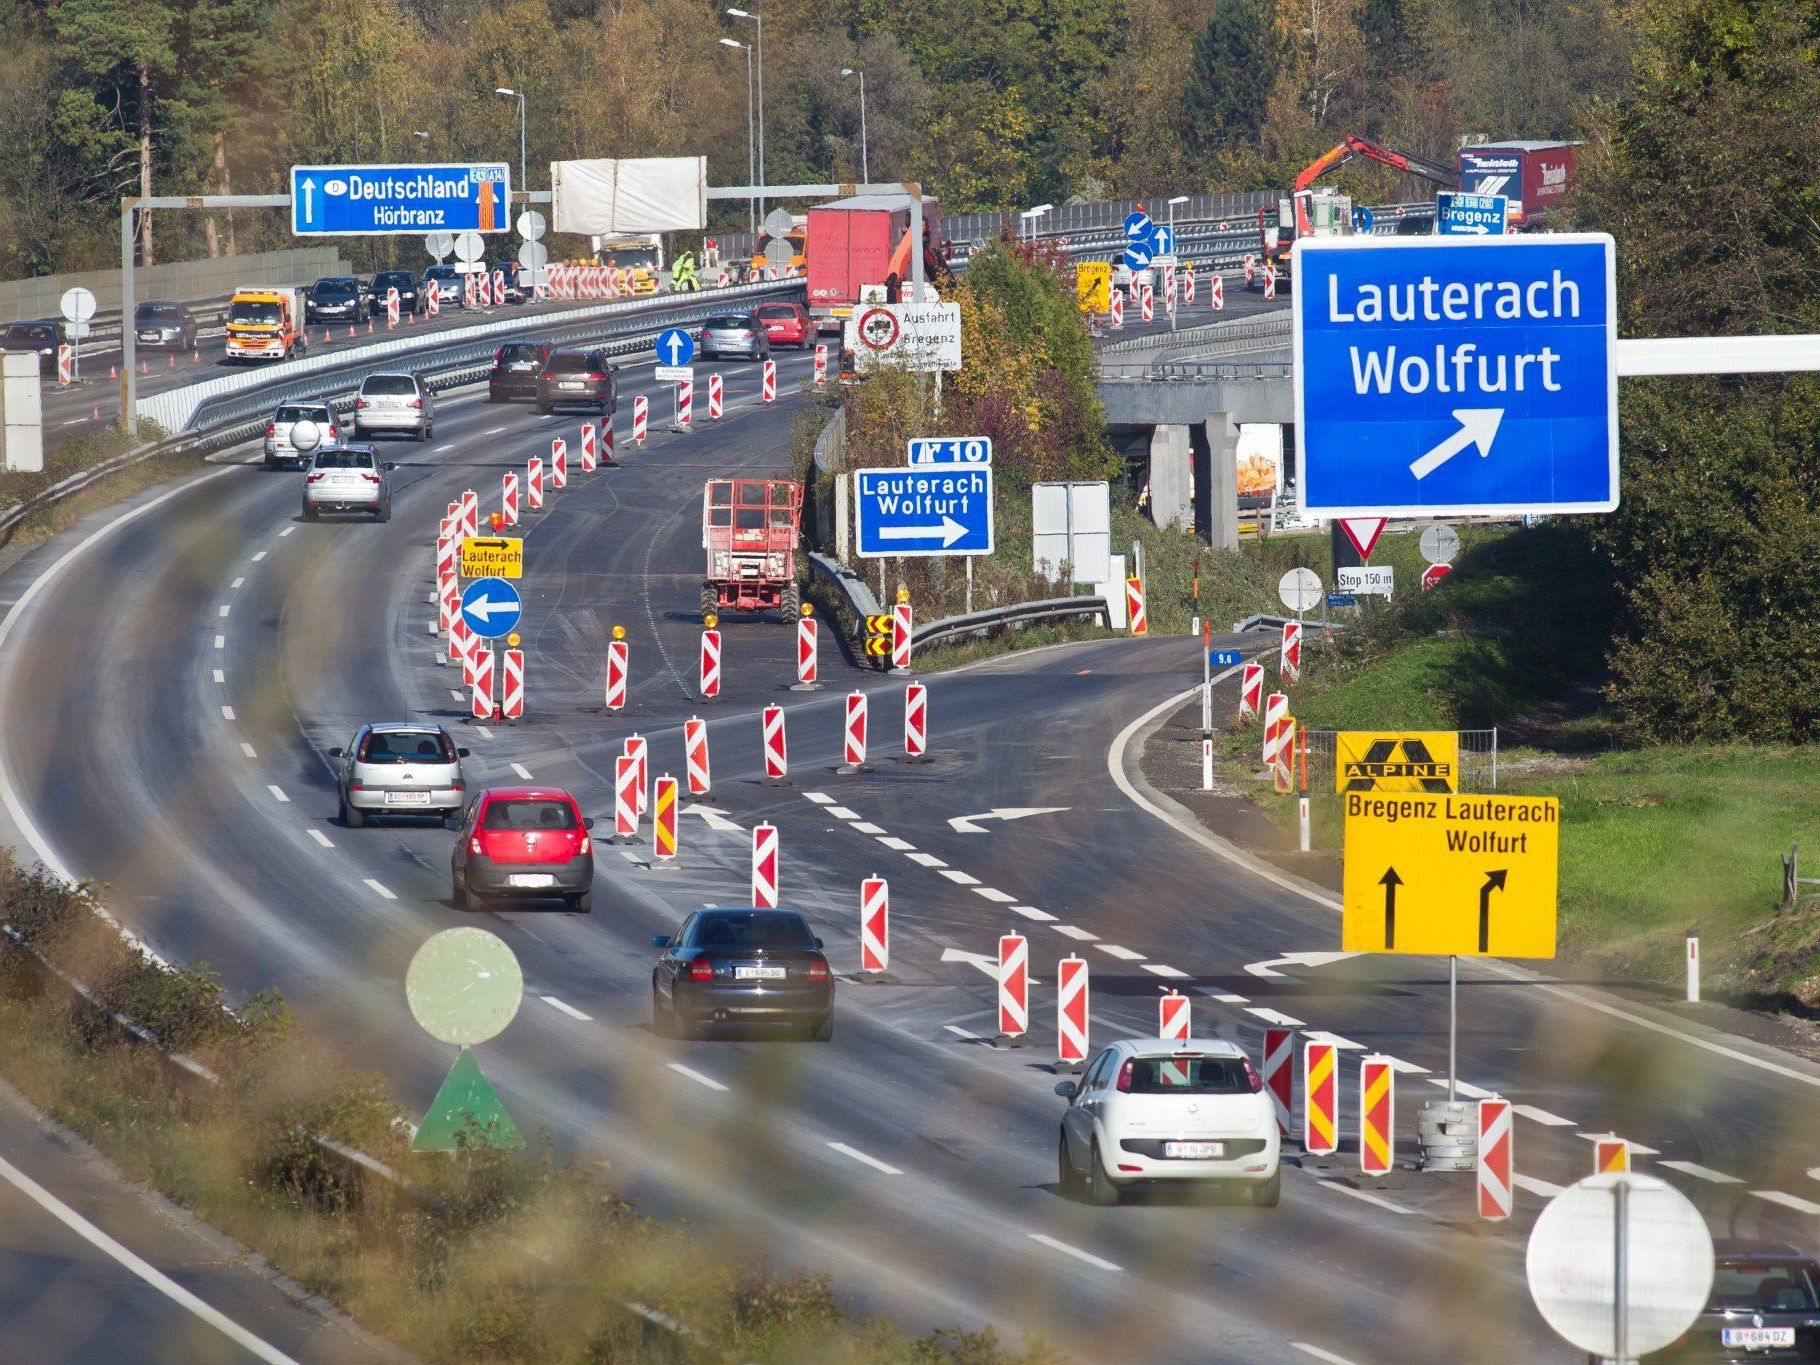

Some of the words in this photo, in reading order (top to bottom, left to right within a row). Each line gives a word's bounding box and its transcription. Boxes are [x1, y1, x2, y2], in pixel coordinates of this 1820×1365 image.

[349, 174, 469, 200] Deutschland
[373, 205, 445, 226] Hörbranz
[1441, 206, 1501, 225] Bregenz
[1078, 265, 1108, 274] Bregenz
[1328, 269, 1580, 323] Lauterach
[903, 312, 955, 324] Ausfahrt
[903, 334, 955, 346] Bregenz
[1349, 343, 1562, 395] Wolfurt
[949, 440, 983, 462] 10
[862, 472, 984, 495] Lauterach
[877, 495, 969, 515] Wolfurt
[462, 549, 521, 562] Lauterach
[462, 564, 506, 577] Wolfurt
[1339, 574, 1362, 587] Stop
[1364, 573, 1381, 585] 150
[1383, 575, 1392, 584] m
[1347, 764, 1449, 777] ALPINE
[1349, 794, 1437, 822] Bregenz
[1446, 797, 1556, 822] Lauterach
[1446, 829, 1527, 853] Wolfurt
